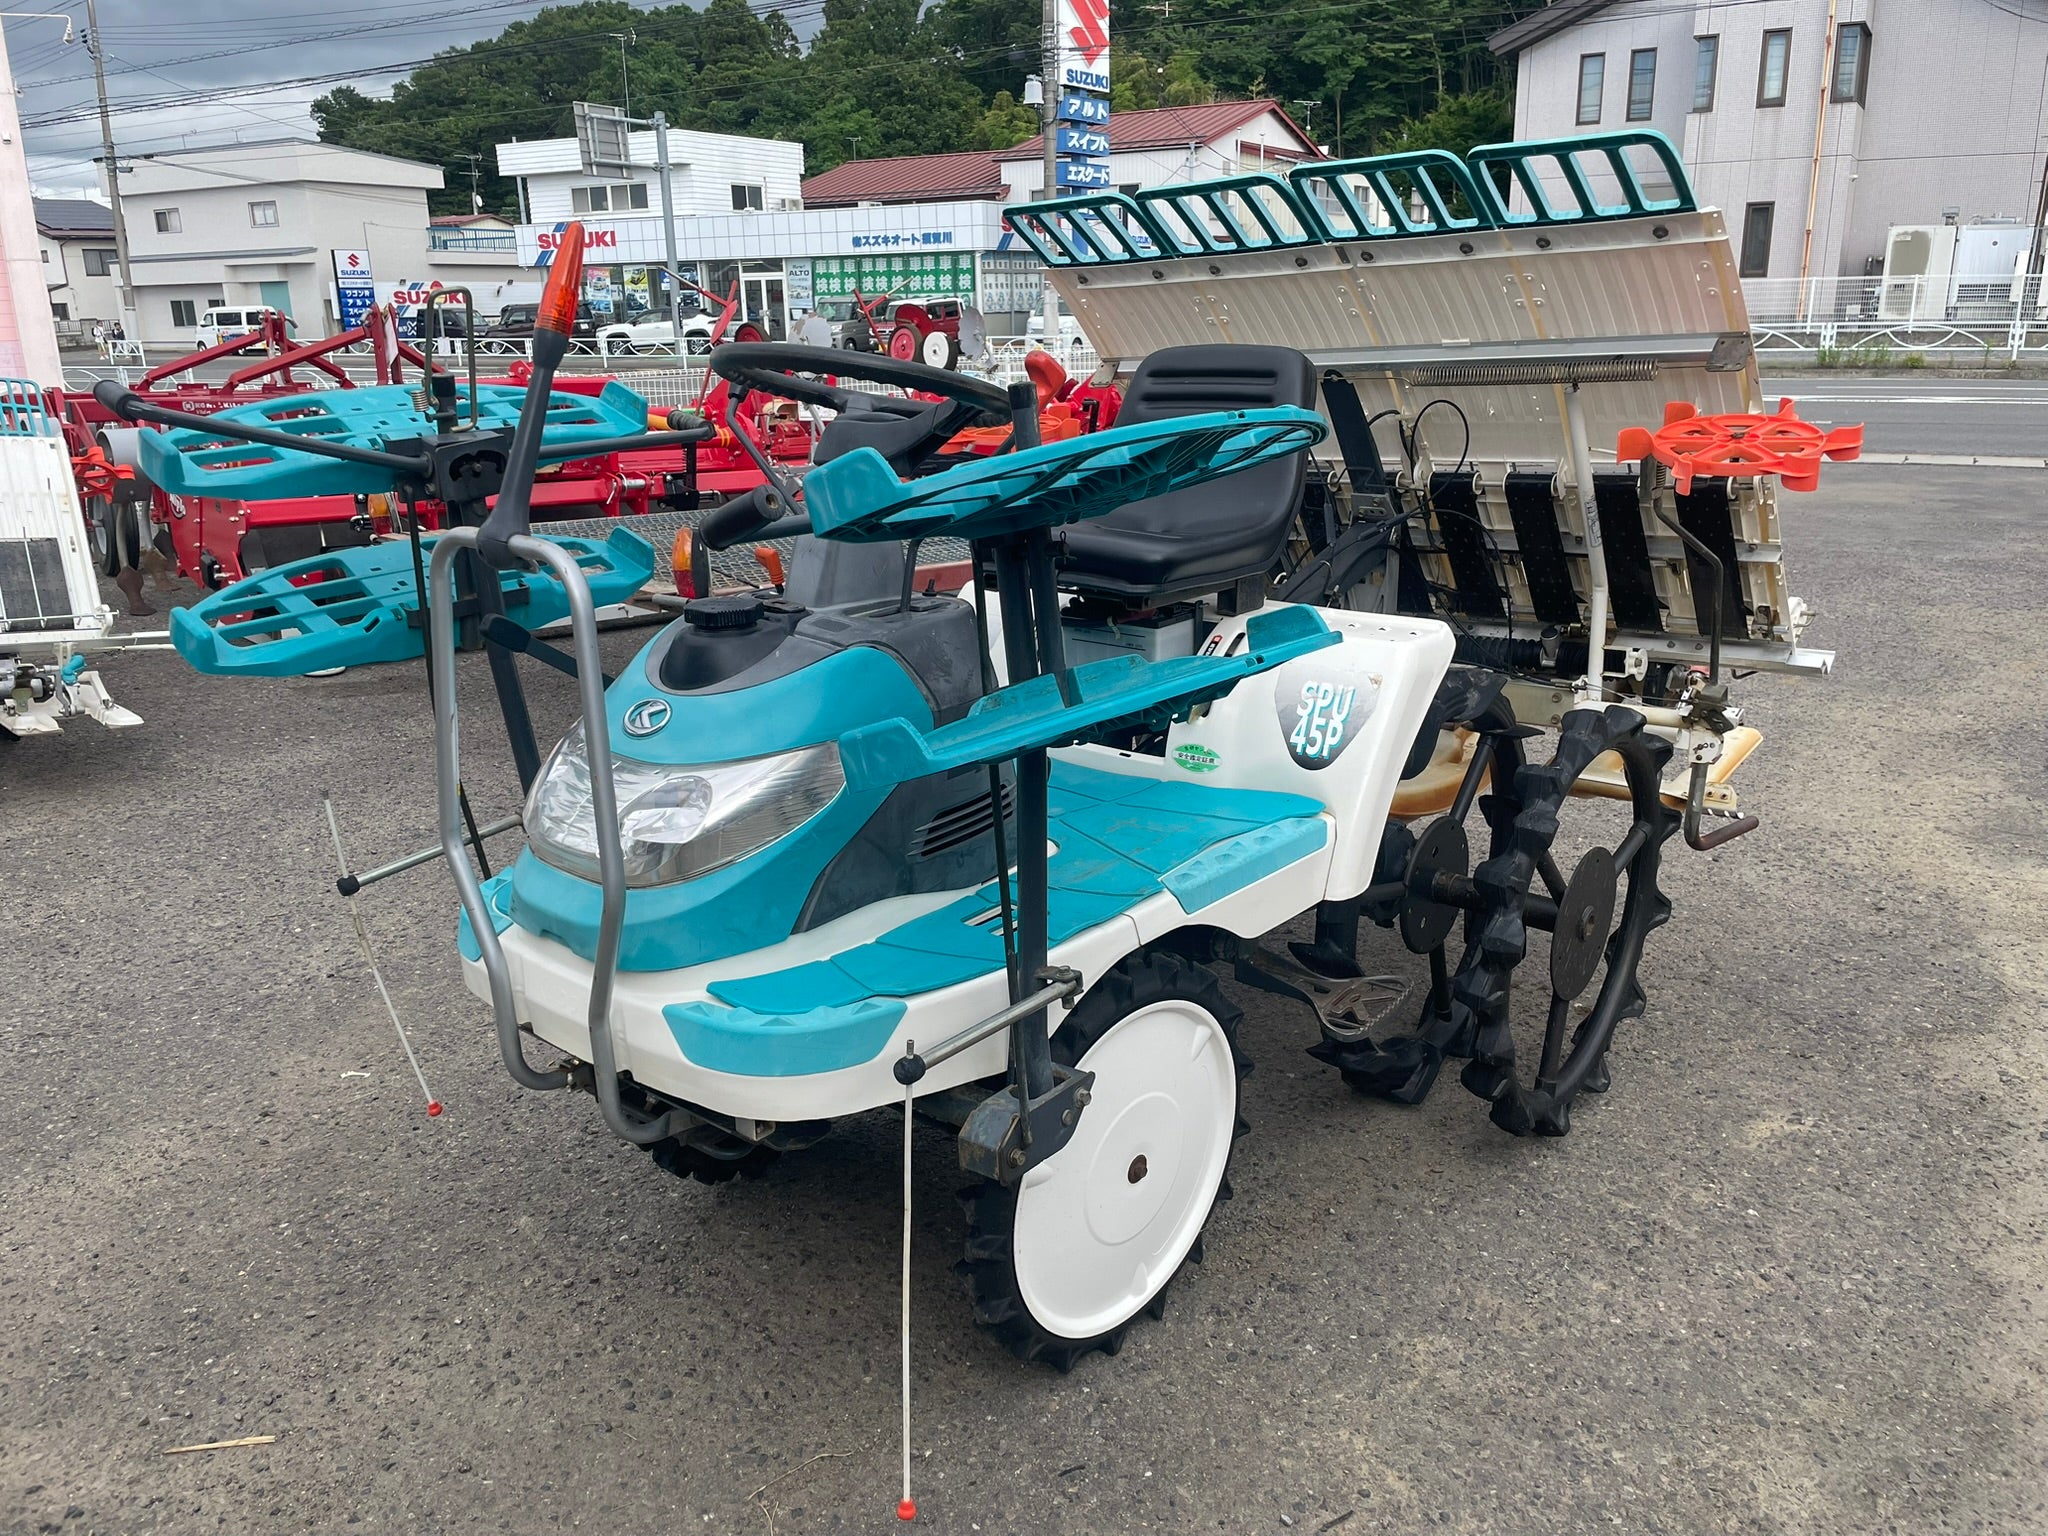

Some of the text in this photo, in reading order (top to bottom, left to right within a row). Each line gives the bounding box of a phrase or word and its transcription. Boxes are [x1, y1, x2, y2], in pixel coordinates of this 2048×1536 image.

[1066, 68, 1109, 90] SUZUKI
[1068, 98, 1108, 120] アルト
[1068, 131, 1109, 152] スイフト
[1067, 165, 1110, 185] エスクード
[537, 230, 617, 250] SUUKI
[347, 299, 371, 307] アルト
[393, 290, 468, 305] SUZKI
[1296, 680, 1356, 723] SPU
[1289, 716, 1345, 759] 45P
